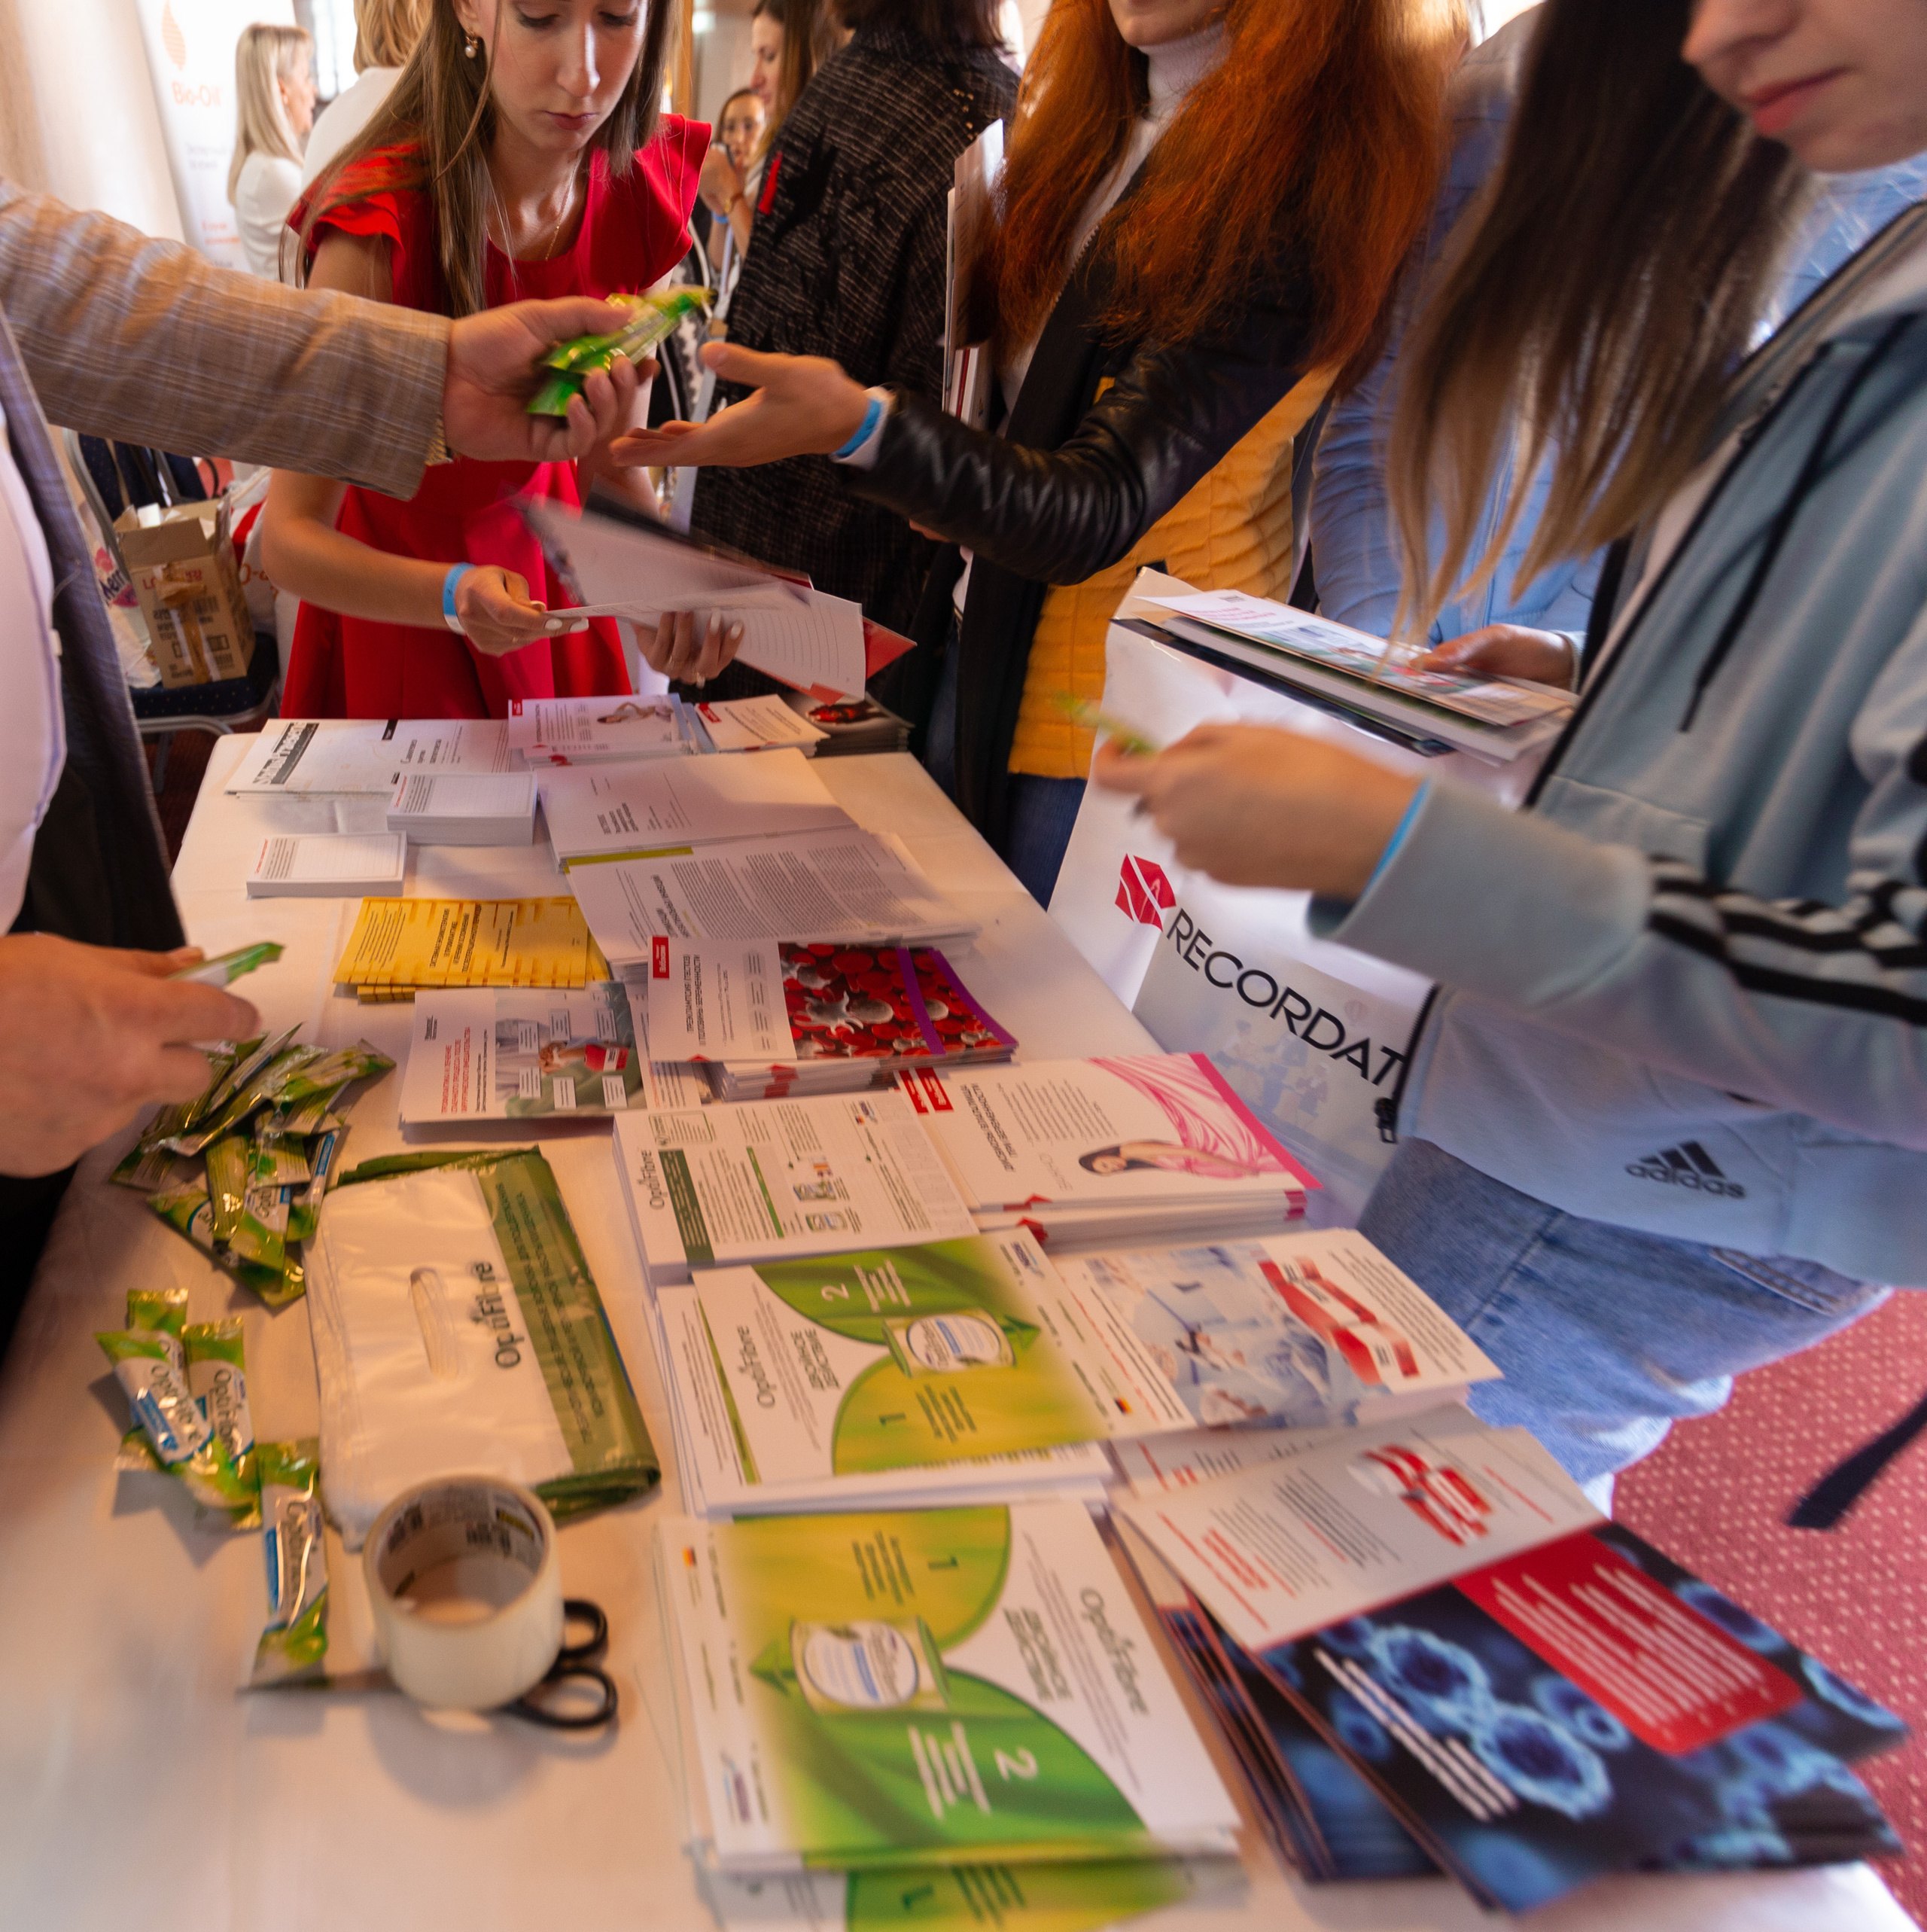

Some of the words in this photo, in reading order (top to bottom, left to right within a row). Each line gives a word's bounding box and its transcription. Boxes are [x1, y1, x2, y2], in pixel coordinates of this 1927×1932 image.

[172, 81, 221, 107] Bio-Oil
[1167, 908, 1405, 1086] RECORDAT
[1624, 1163, 1746, 1199] adidas
[820, 1282, 851, 1302] 2
[471, 1260, 525, 1370] OptiFibre
[877, 1412, 906, 1426] 1
[928, 1555, 959, 1570] 1
[994, 1746, 1040, 1781] 2
